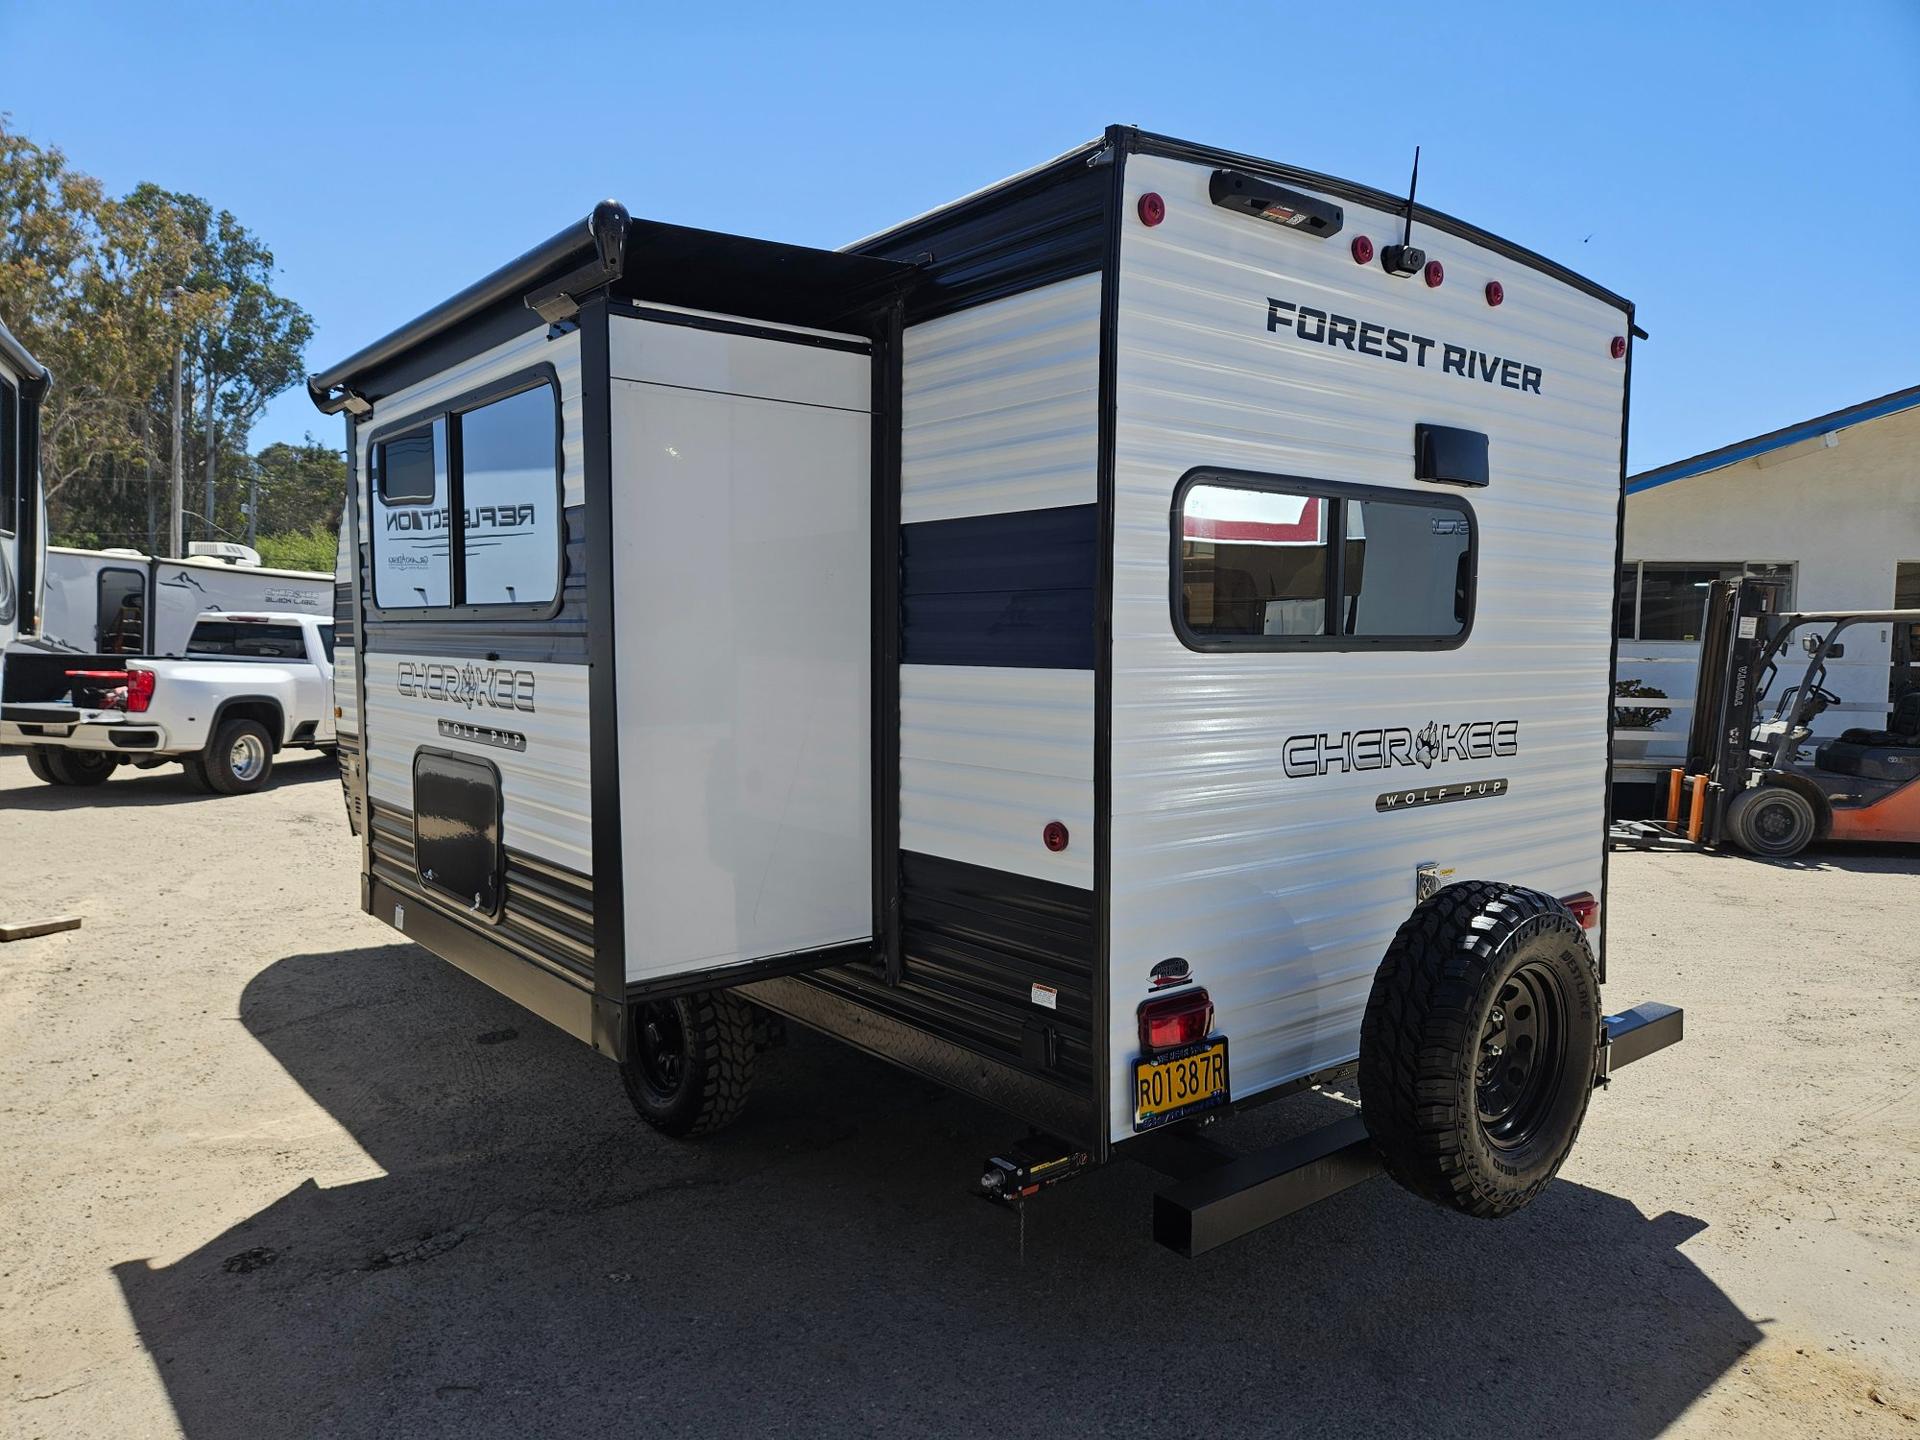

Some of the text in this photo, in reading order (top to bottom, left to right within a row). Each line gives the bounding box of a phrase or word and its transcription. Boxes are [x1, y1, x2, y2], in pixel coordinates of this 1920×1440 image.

[1266, 296, 1543, 395] FOREST RIVER
[441, 721, 521, 747] WOLF PUP
[1282, 720, 1519, 779] CHEROKEE
[1386, 781, 1501, 807] WOLF PUP
